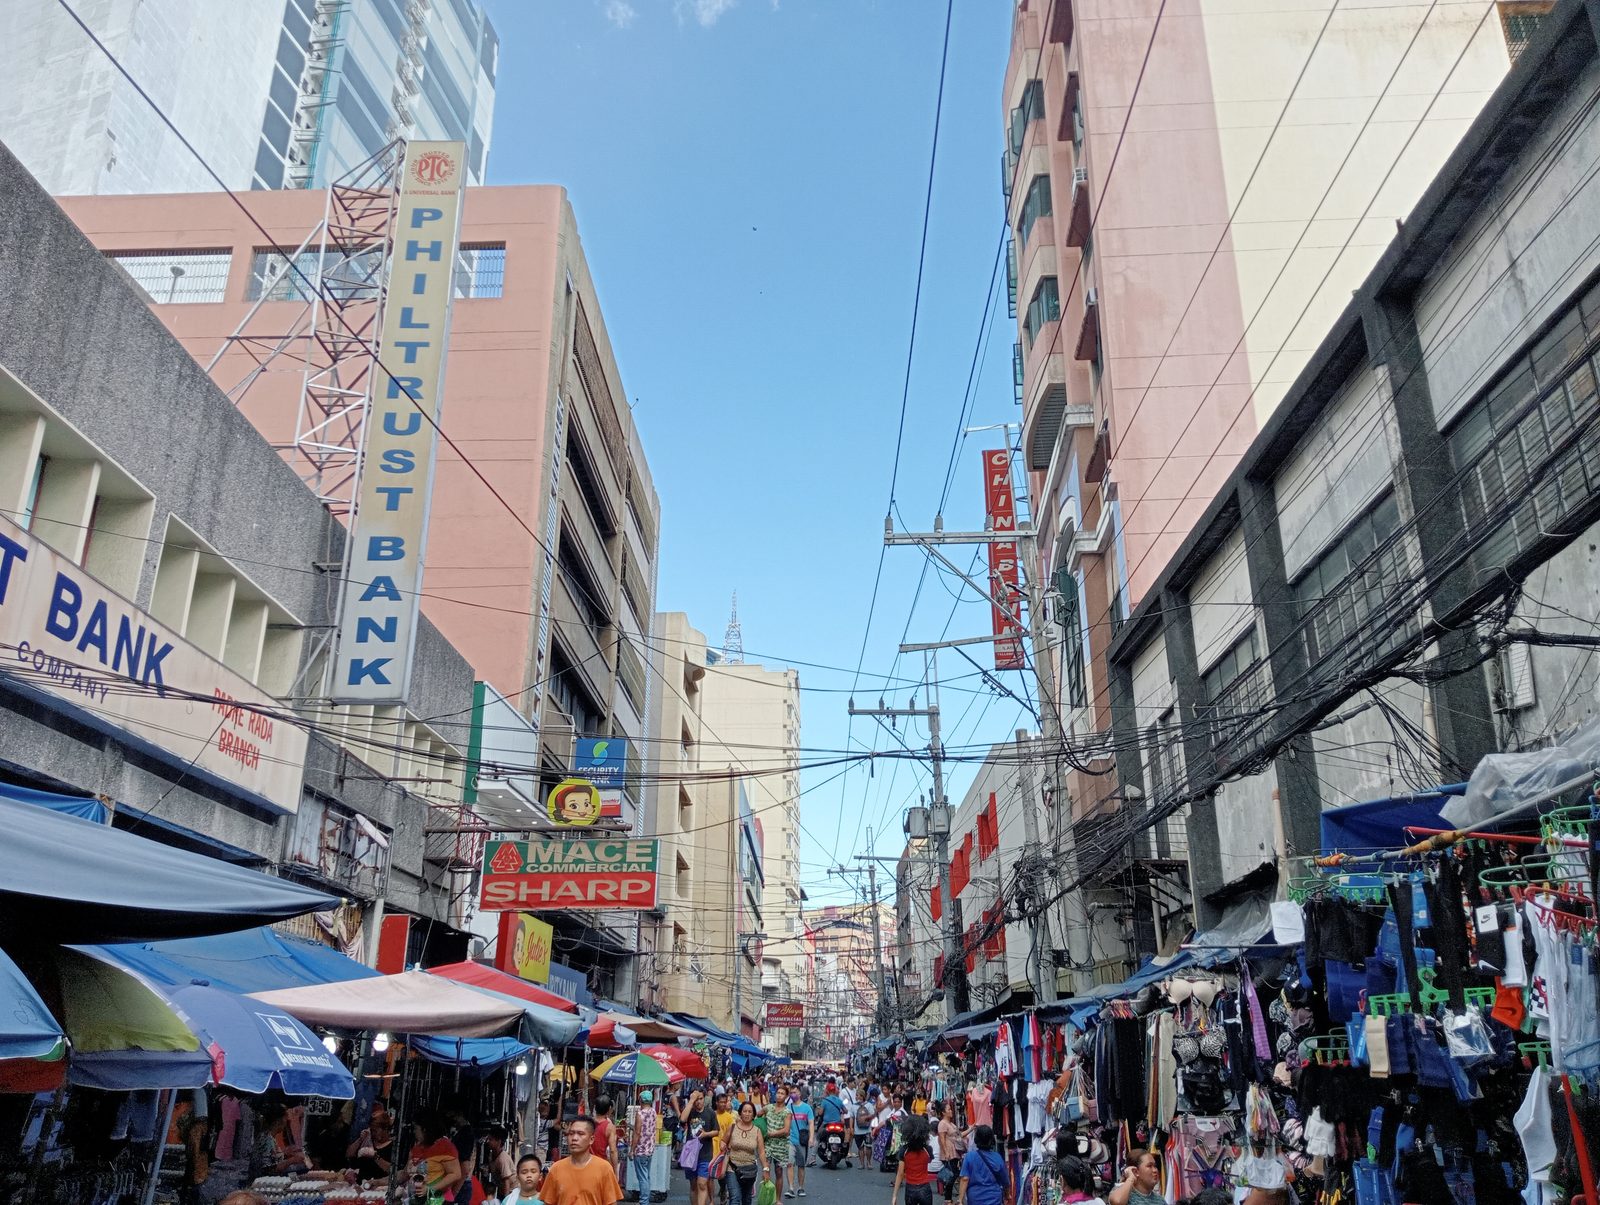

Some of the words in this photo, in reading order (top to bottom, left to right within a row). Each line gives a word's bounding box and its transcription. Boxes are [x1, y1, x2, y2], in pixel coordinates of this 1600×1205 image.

[417, 154, 449, 182] PTC
[376, 207, 443, 511] PHILTRUST
[347, 536, 406, 686] BANK
[45, 571, 174, 699] BANK
[17, 641, 109, 704] COMPANY
[212, 687, 244, 728] PADRE
[247, 711, 273, 744] RADA
[218, 729, 260, 771] BRANCH
[526, 841, 653, 863] MACE
[526, 863, 652, 873] COMMERCIAL
[485, 880, 651, 901] SHARP
[525, 931, 548, 966] Julie's
